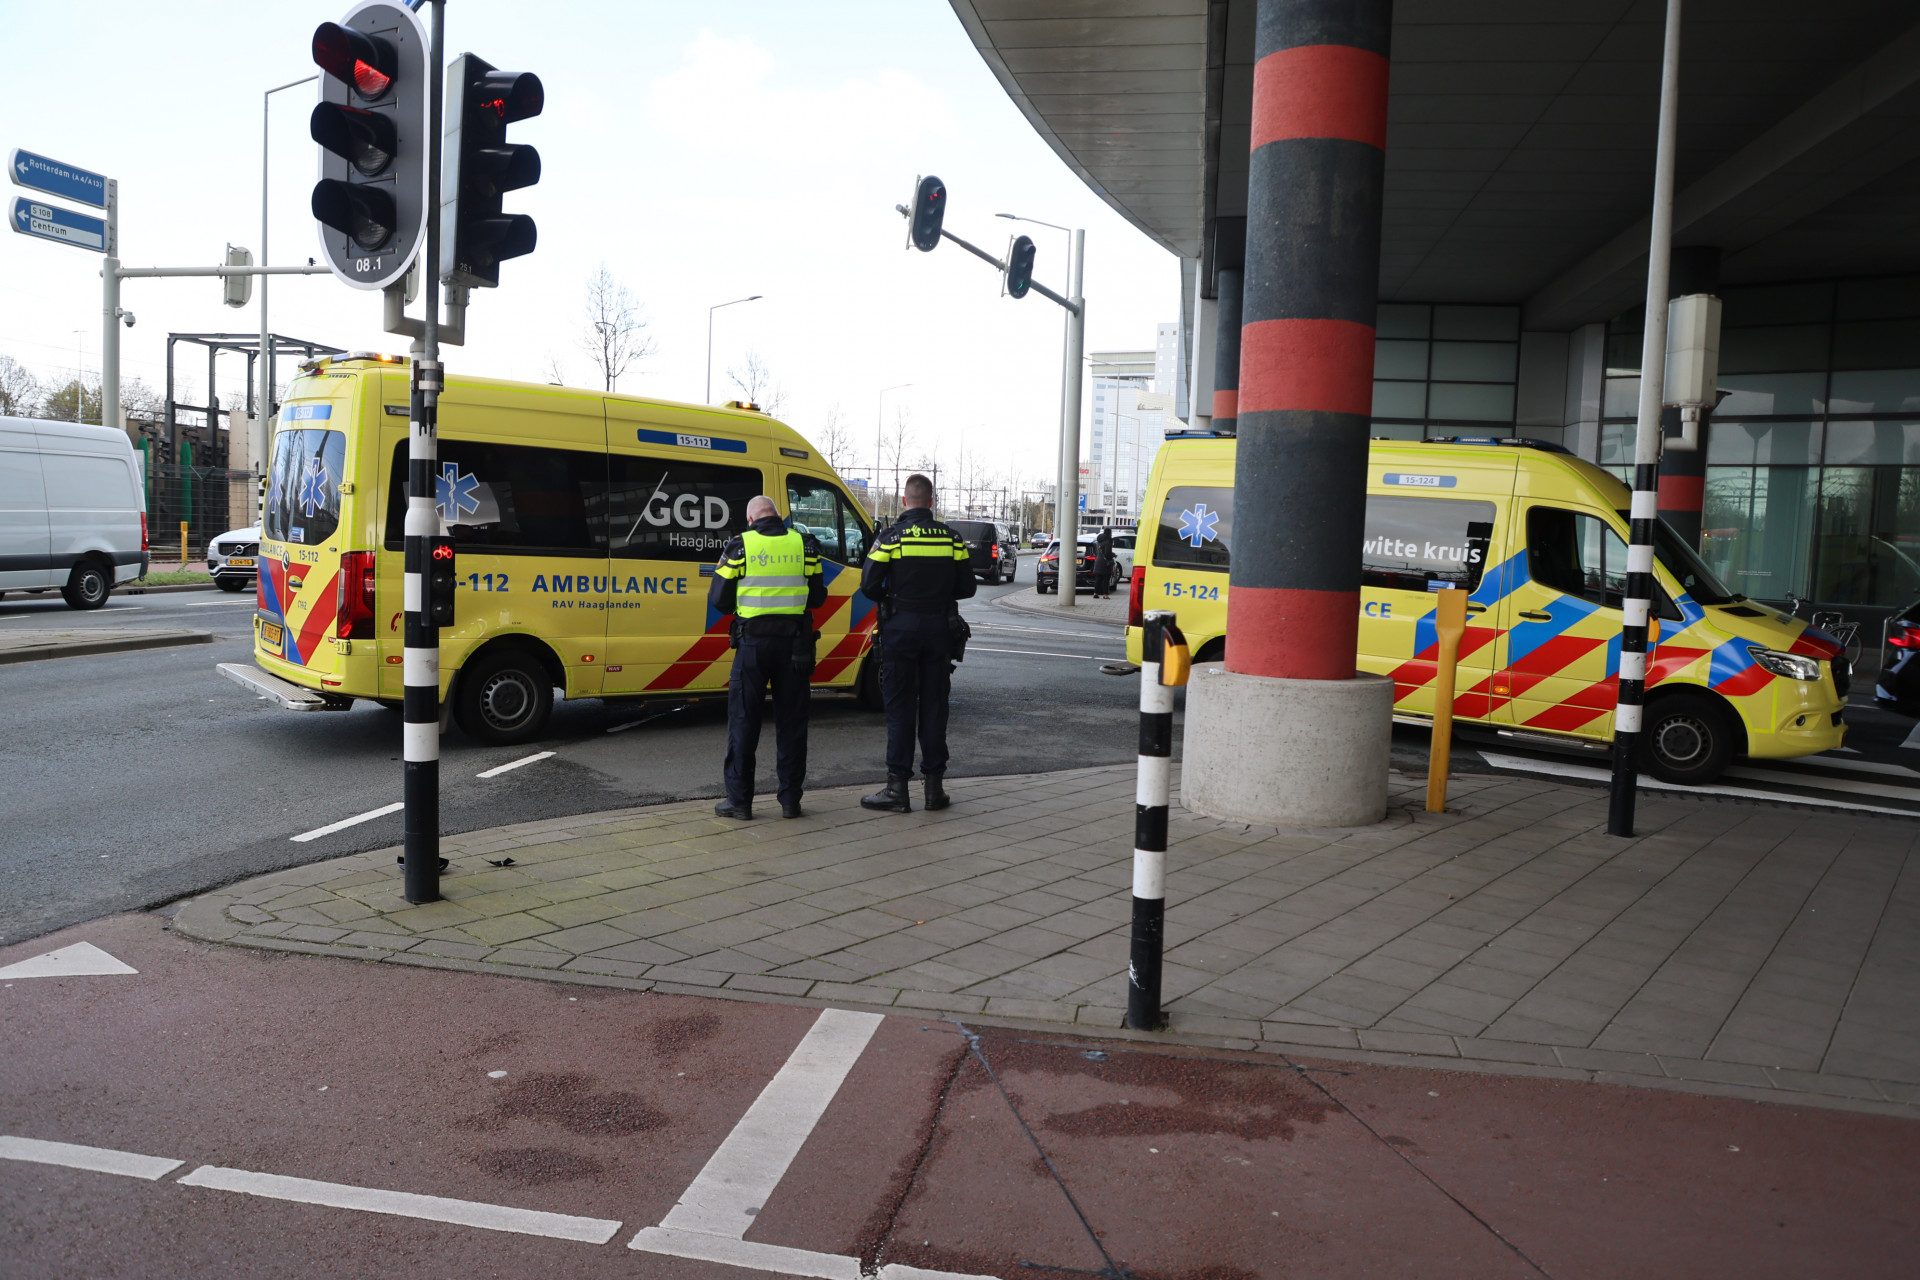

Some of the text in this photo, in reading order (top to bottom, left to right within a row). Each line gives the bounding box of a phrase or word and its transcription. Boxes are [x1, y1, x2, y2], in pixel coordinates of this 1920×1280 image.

[28, 158, 70, 179] Rotterdam
[31, 220, 67, 236] Centrum
[356, 256, 381, 272] 08.1
[680, 436, 709, 447] 15-112
[1405, 476, 1434, 485] 15-124
[642, 490, 730, 529] GGD
[298, 549, 319, 562] 15-112
[1424, 541, 1481, 563] kruis
[531, 574, 688, 595] AMBULANCE
[1163, 582, 1219, 601] 15-124
[552, 600, 641, 611] RAV Haaglanden
